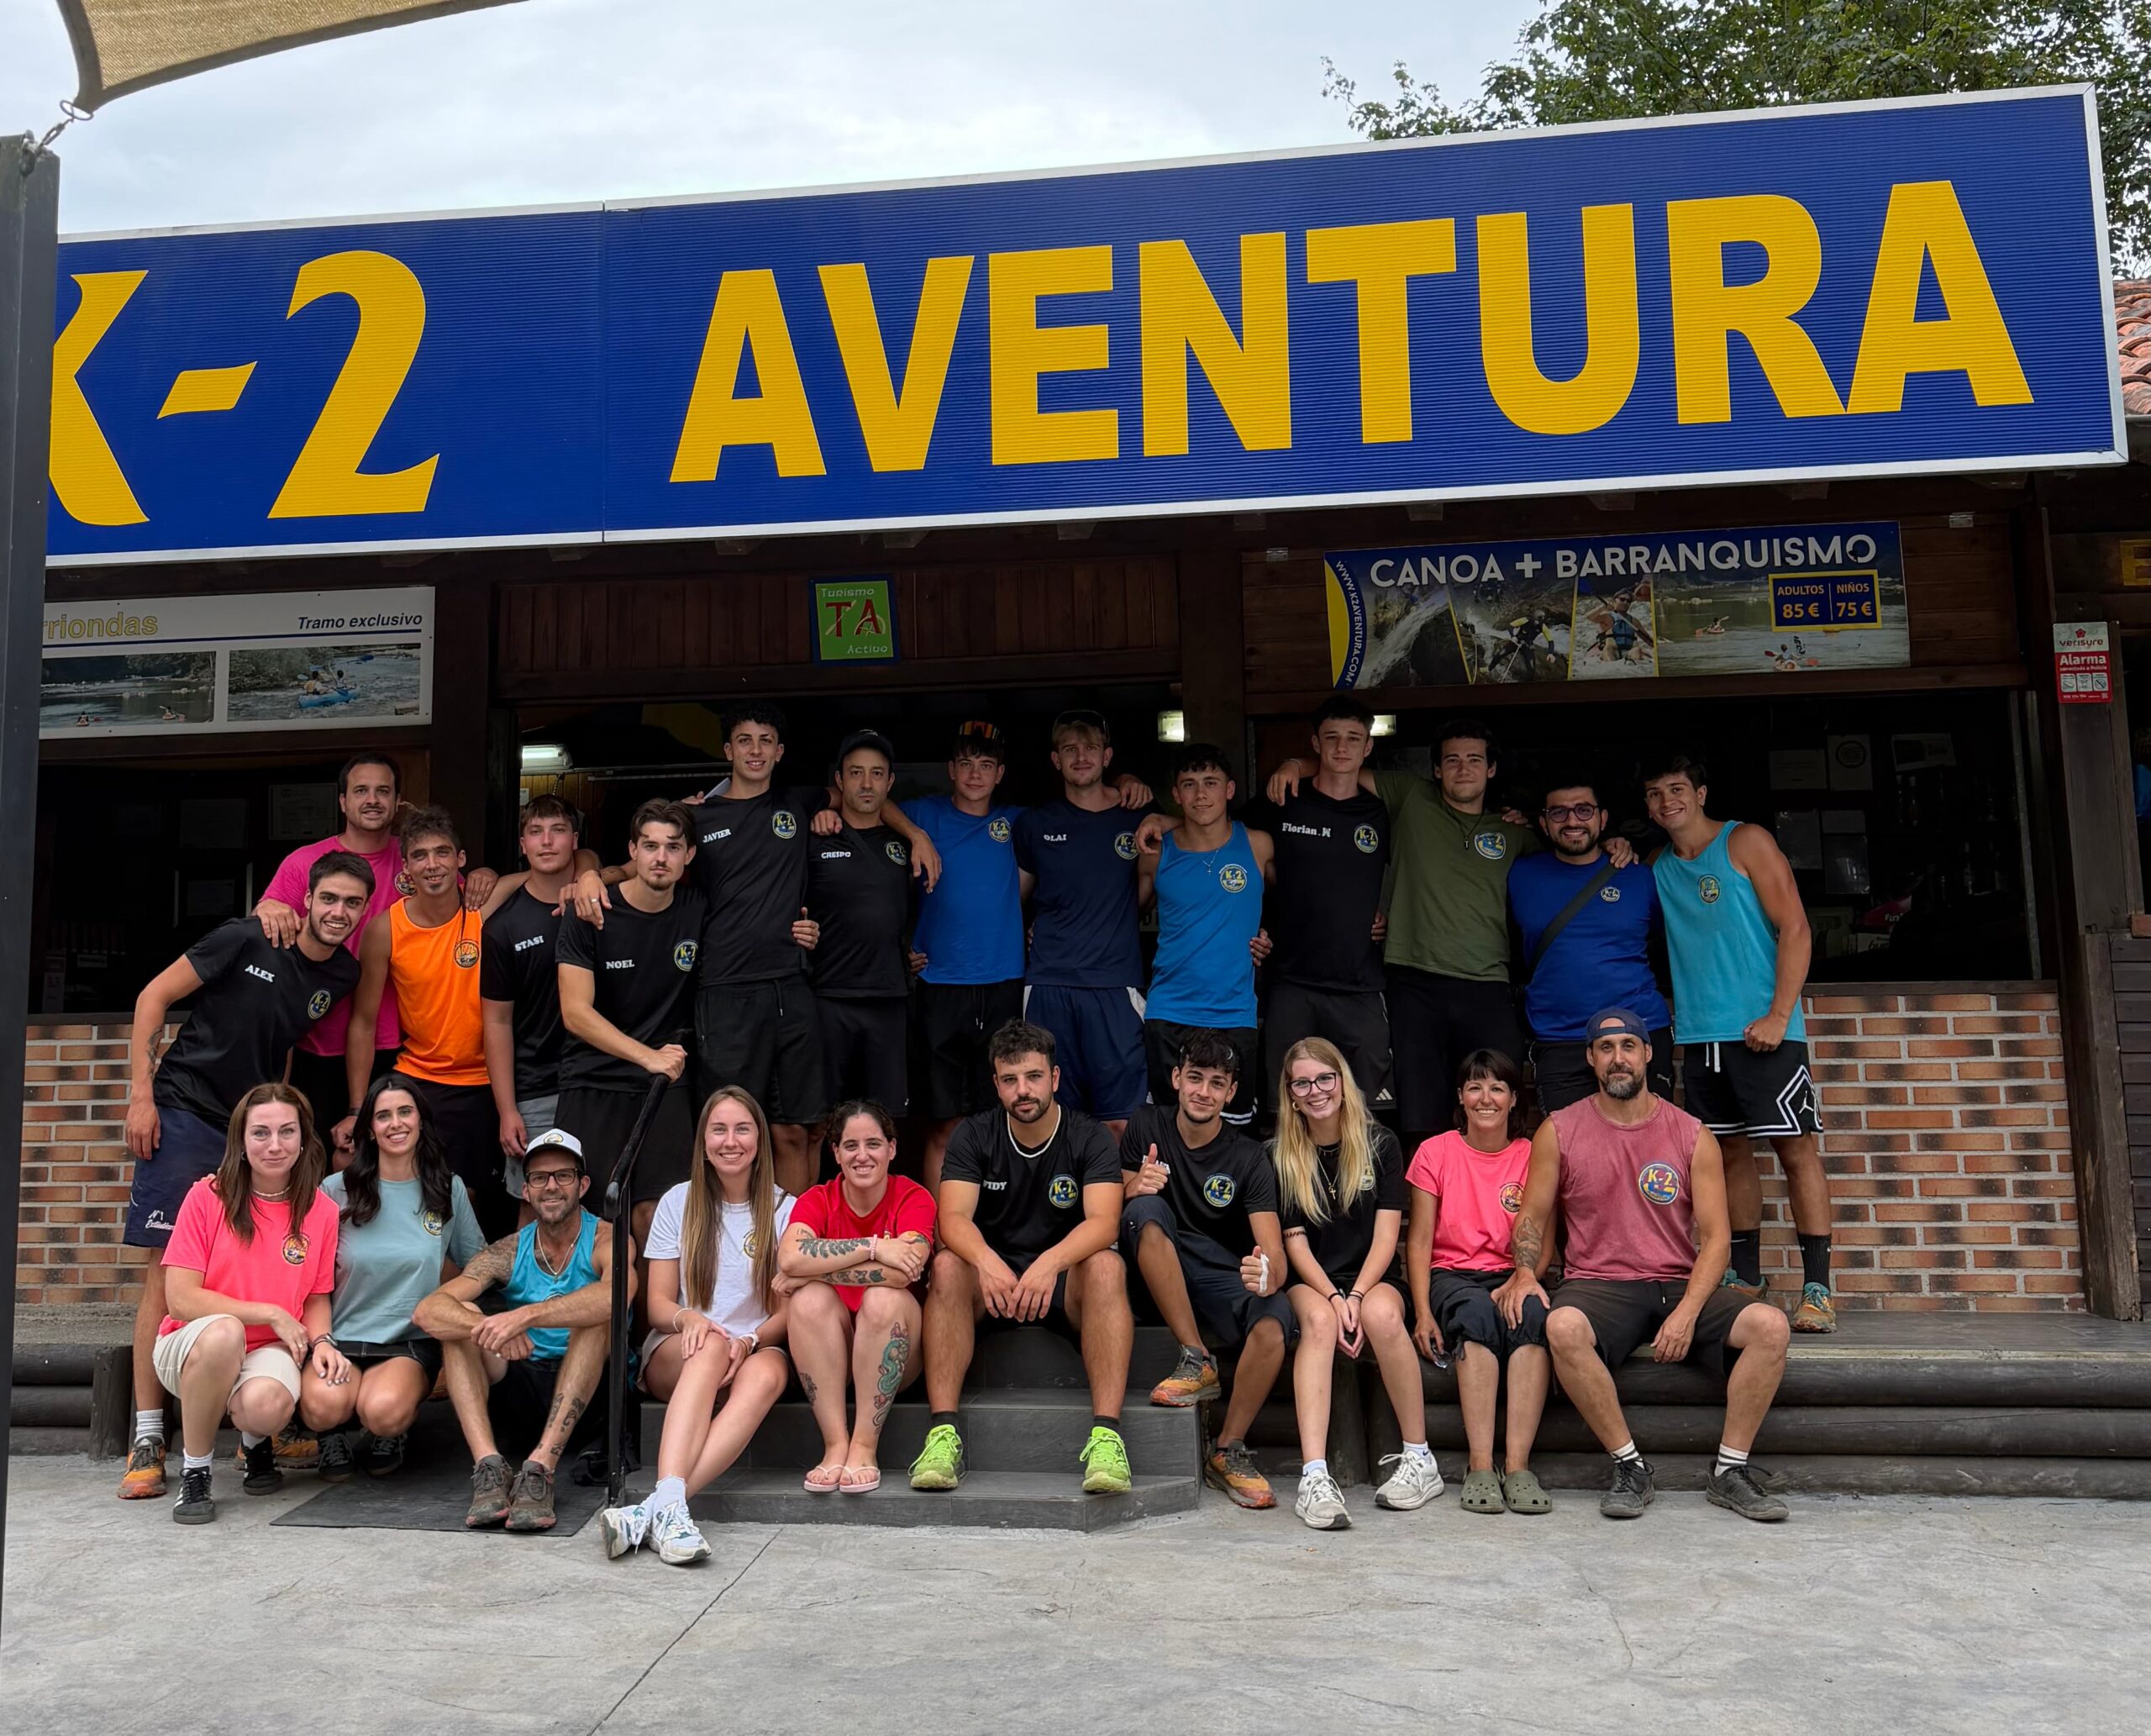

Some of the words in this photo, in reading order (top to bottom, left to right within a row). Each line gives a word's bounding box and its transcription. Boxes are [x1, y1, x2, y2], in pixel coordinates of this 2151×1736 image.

[669, 179, 2034, 483] AVENTURA
[1370, 552, 1504, 587] CANOA
[1556, 534, 1877, 578] BARRANQUISMO
[821, 588, 875, 597] Turismo
[1777, 585, 1824, 596] ADULTOS
[1836, 581, 1870, 594] NIÑOS
[1782, 603, 1804, 618] 85
[1808, 602, 1820, 618] €
[1836, 602, 1857, 618] 75
[1861, 601, 1873, 617] €
[298, 617, 345, 629] Tramo
[350, 613, 422, 628] exclusivo
[2059, 639, 2104, 647] verisure
[2059, 654, 2106, 666] Alarma
[702, 829, 732, 844] JAVIER
[1044, 834, 1067, 842] OLAI
[821, 851, 851, 860] CRESPO
[514, 935, 544, 952] STASI
[606, 960, 634, 970] NOEL
[245, 965, 275, 982] ALEX
[1648, 1169, 1672, 1186] K-2
